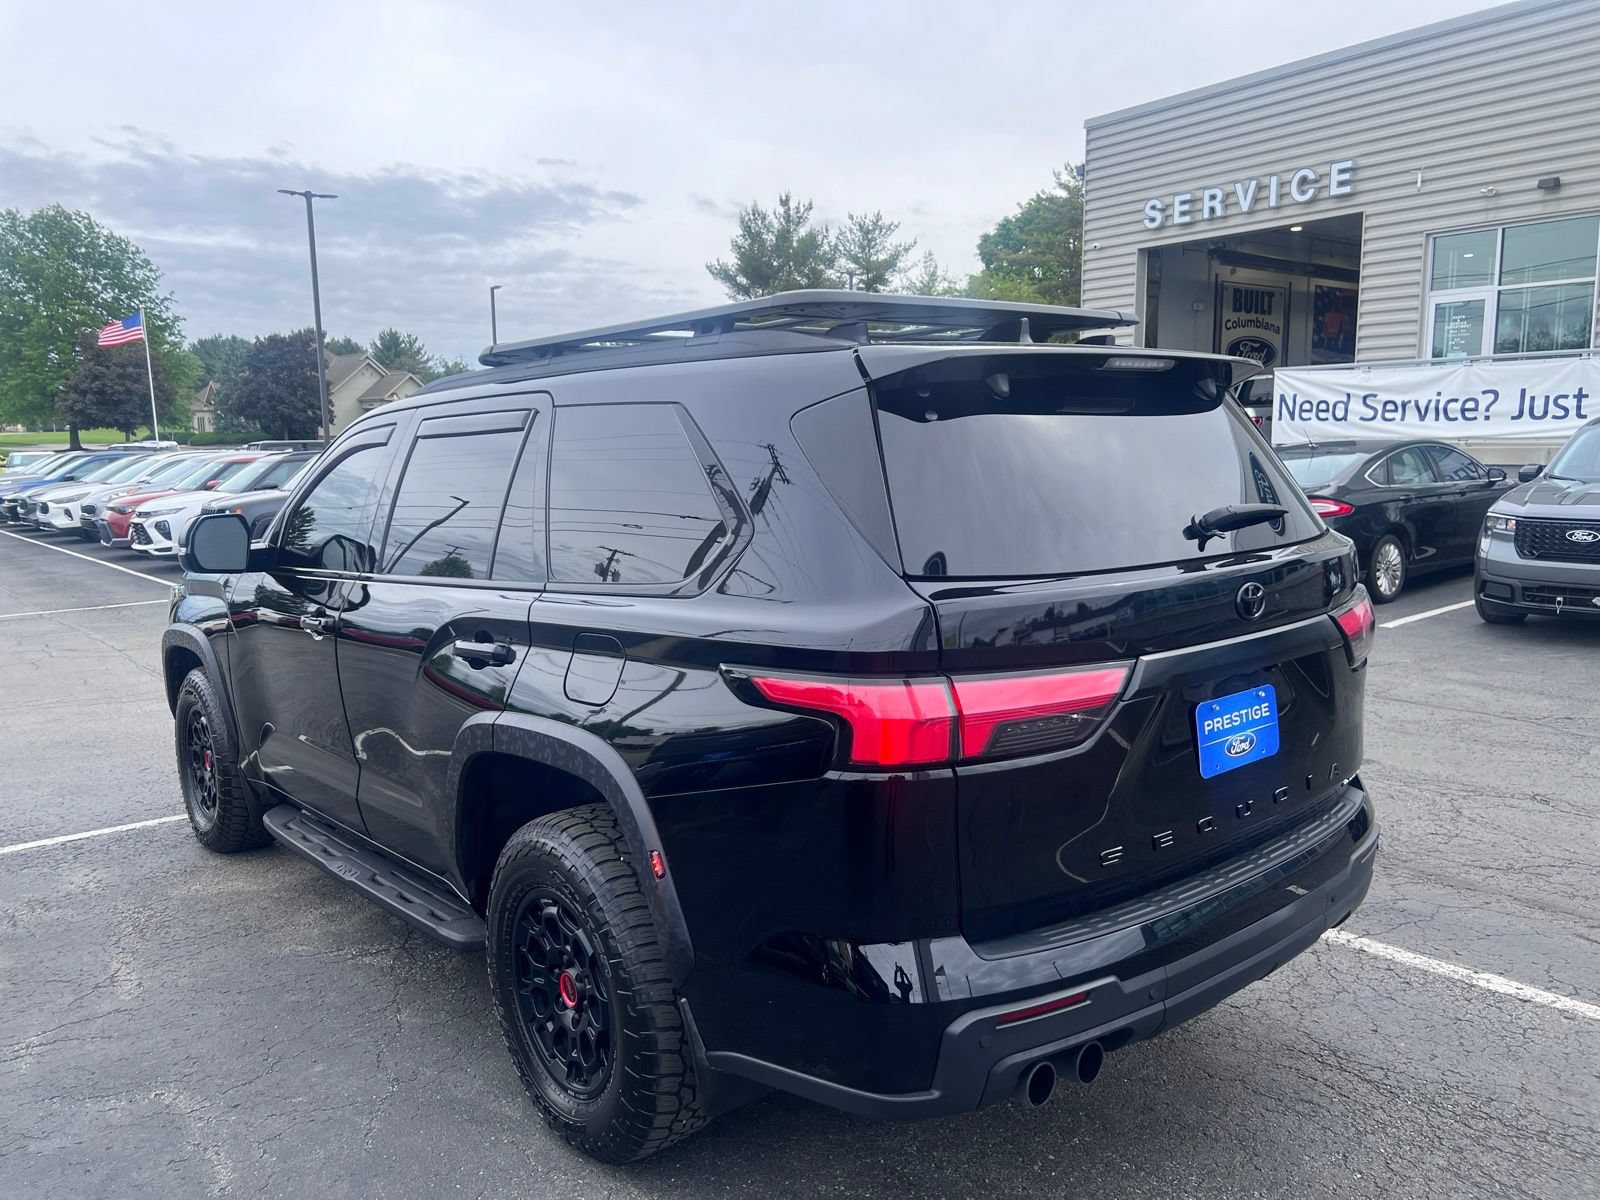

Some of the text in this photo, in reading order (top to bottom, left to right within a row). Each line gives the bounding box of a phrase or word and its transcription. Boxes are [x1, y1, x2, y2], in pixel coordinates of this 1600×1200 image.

[1143, 159, 1354, 230] SERVICE
[1232, 287, 1275, 316] BUILT
[1224, 317, 1280, 335] Columbiana
[1235, 341, 1268, 361] Ford
[1277, 387, 1590, 423] Need Service? Just
[1204, 703, 1271, 735] PRESTIGE
[1230, 735, 1252, 754] Ford
[1100, 762, 1340, 866] SEQUOIA
